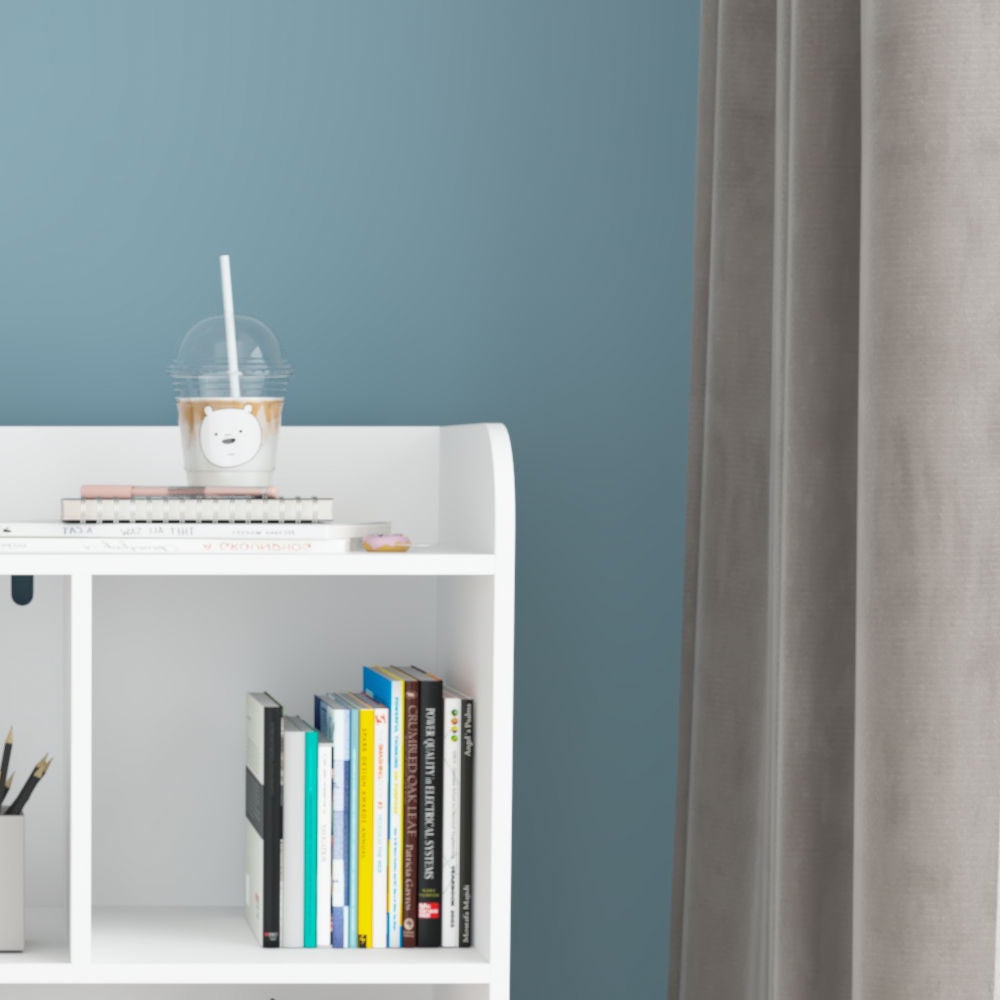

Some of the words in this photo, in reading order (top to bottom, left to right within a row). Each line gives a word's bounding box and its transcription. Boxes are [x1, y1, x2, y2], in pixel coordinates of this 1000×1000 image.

[407, 705, 418, 774] CRUMBLED
[425, 707, 436, 737] POWER
[424, 738, 436, 776] QUALITY
[407, 775, 417, 803] OAK
[407, 805, 417, 838] LEAF
[424, 785, 435, 839] ELECTRICAL
[423, 840, 435, 880] SYSTEMS
